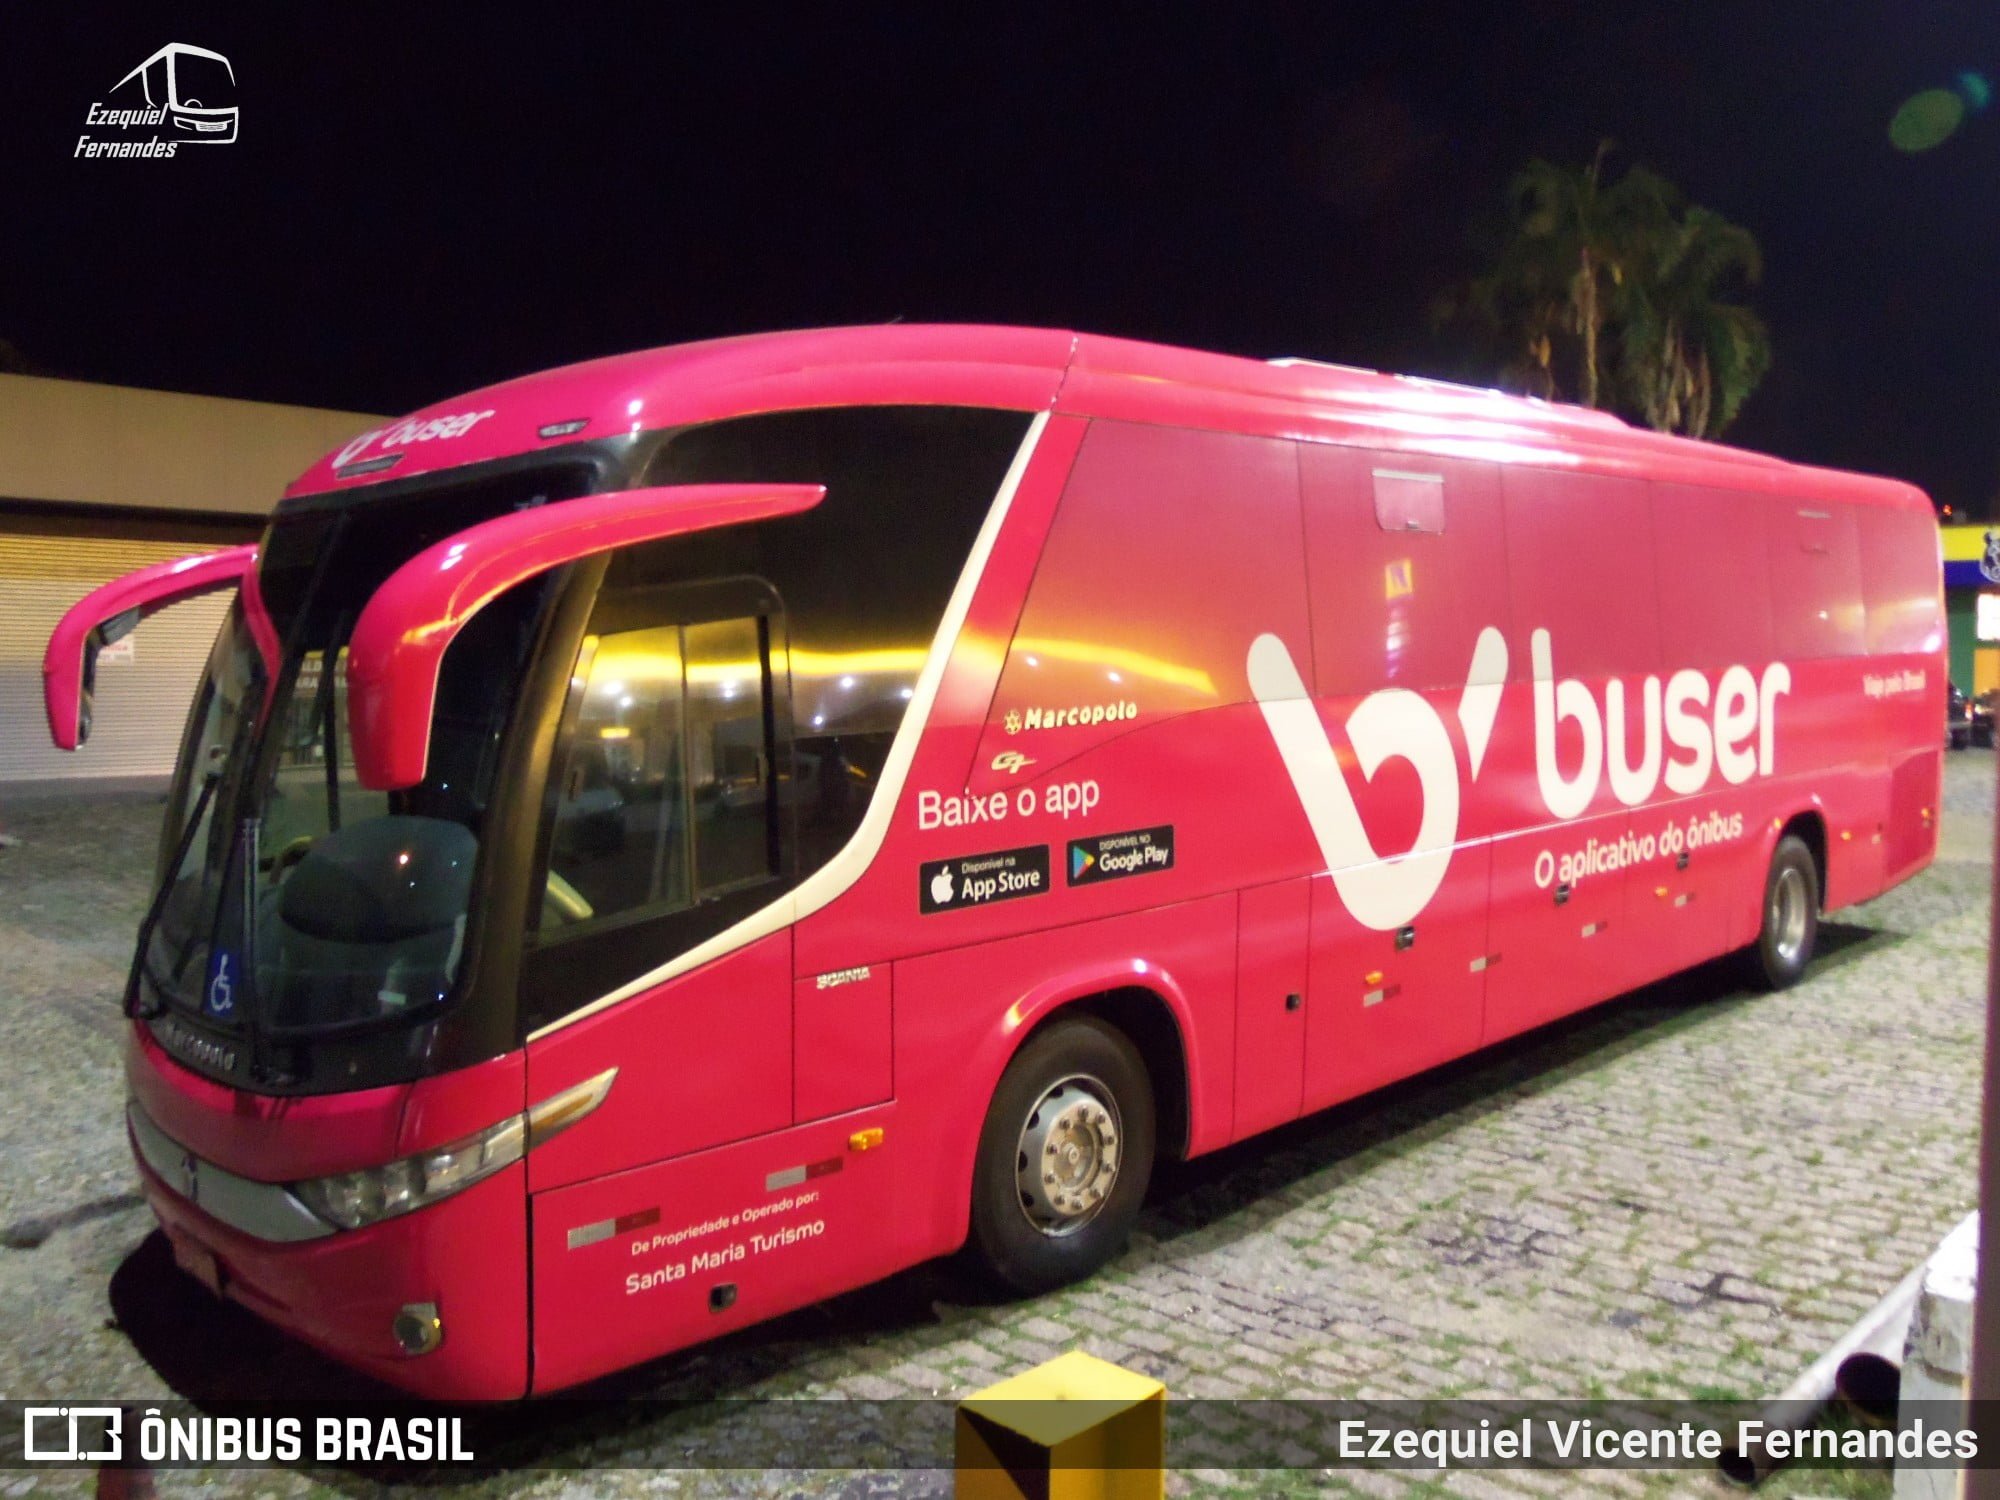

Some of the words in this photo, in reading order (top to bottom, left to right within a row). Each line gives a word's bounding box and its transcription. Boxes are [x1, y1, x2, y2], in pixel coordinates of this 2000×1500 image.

[1023, 699, 1138, 731] Marcopolo
[1531, 627, 1791, 819] buser
[918, 786, 1009, 831] Baixe
[1016, 787, 1037, 817] o
[1044, 779, 1100, 820] app
[1099, 847, 1143, 872] Google
[1144, 844, 1169, 866] Play
[1534, 849, 1555, 889] O
[1558, 829, 1656, 889] aplicativo
[1658, 819, 1683, 857] do
[1686, 810, 1743, 850] ônibus
[961, 876, 997, 902] App
[998, 870, 1041, 893] Store
[816, 965, 870, 990] SCANIA
[631, 1241, 650, 1256] De
[652, 1213, 730, 1249] Propriedade
[732, 1214, 740, 1226] e
[741, 1196, 794, 1223] Operado
[795, 1191, 819, 1209] por:
[625, 1263, 686, 1296] Santa
[691, 1243, 746, 1274] Maria
[749, 1219, 826, 1255] Turismo
